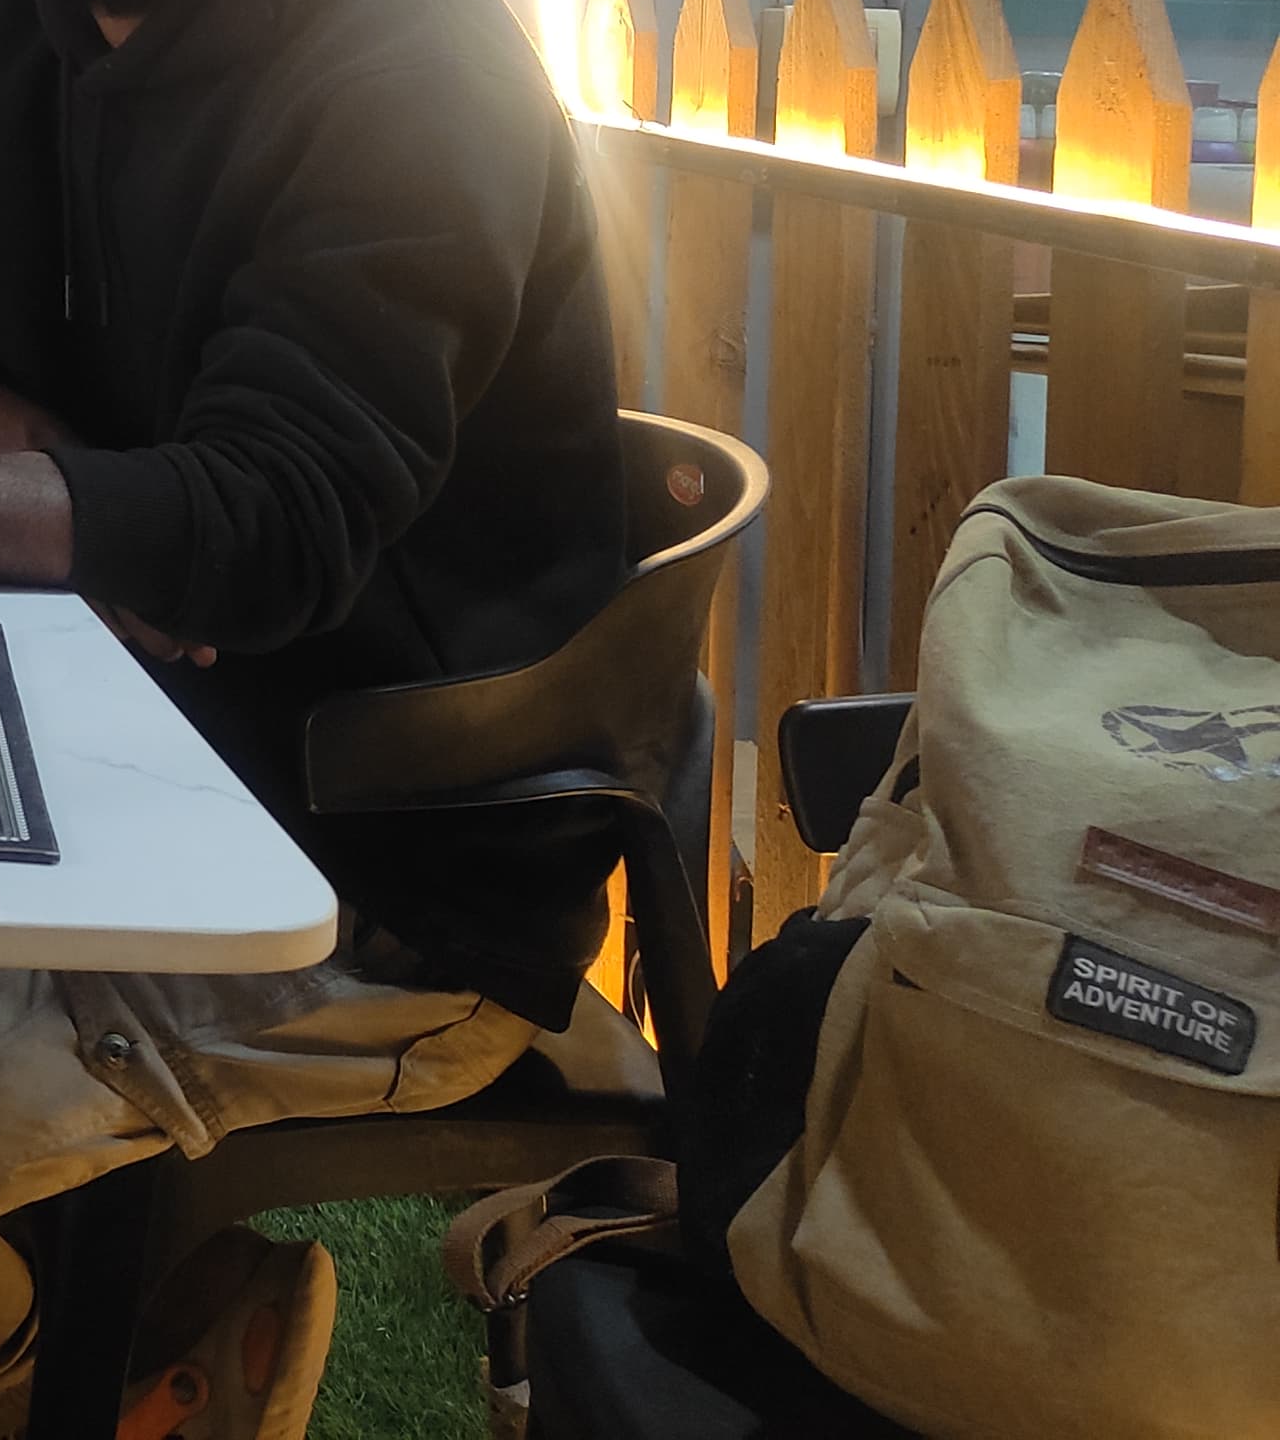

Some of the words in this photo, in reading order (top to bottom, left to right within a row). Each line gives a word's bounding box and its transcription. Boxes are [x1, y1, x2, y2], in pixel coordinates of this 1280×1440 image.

[1063, 980, 1234, 1055] ADVENTURE
[1072, 957, 1185, 1007] SPIRIT
[1191, 999, 1240, 1027] OF
